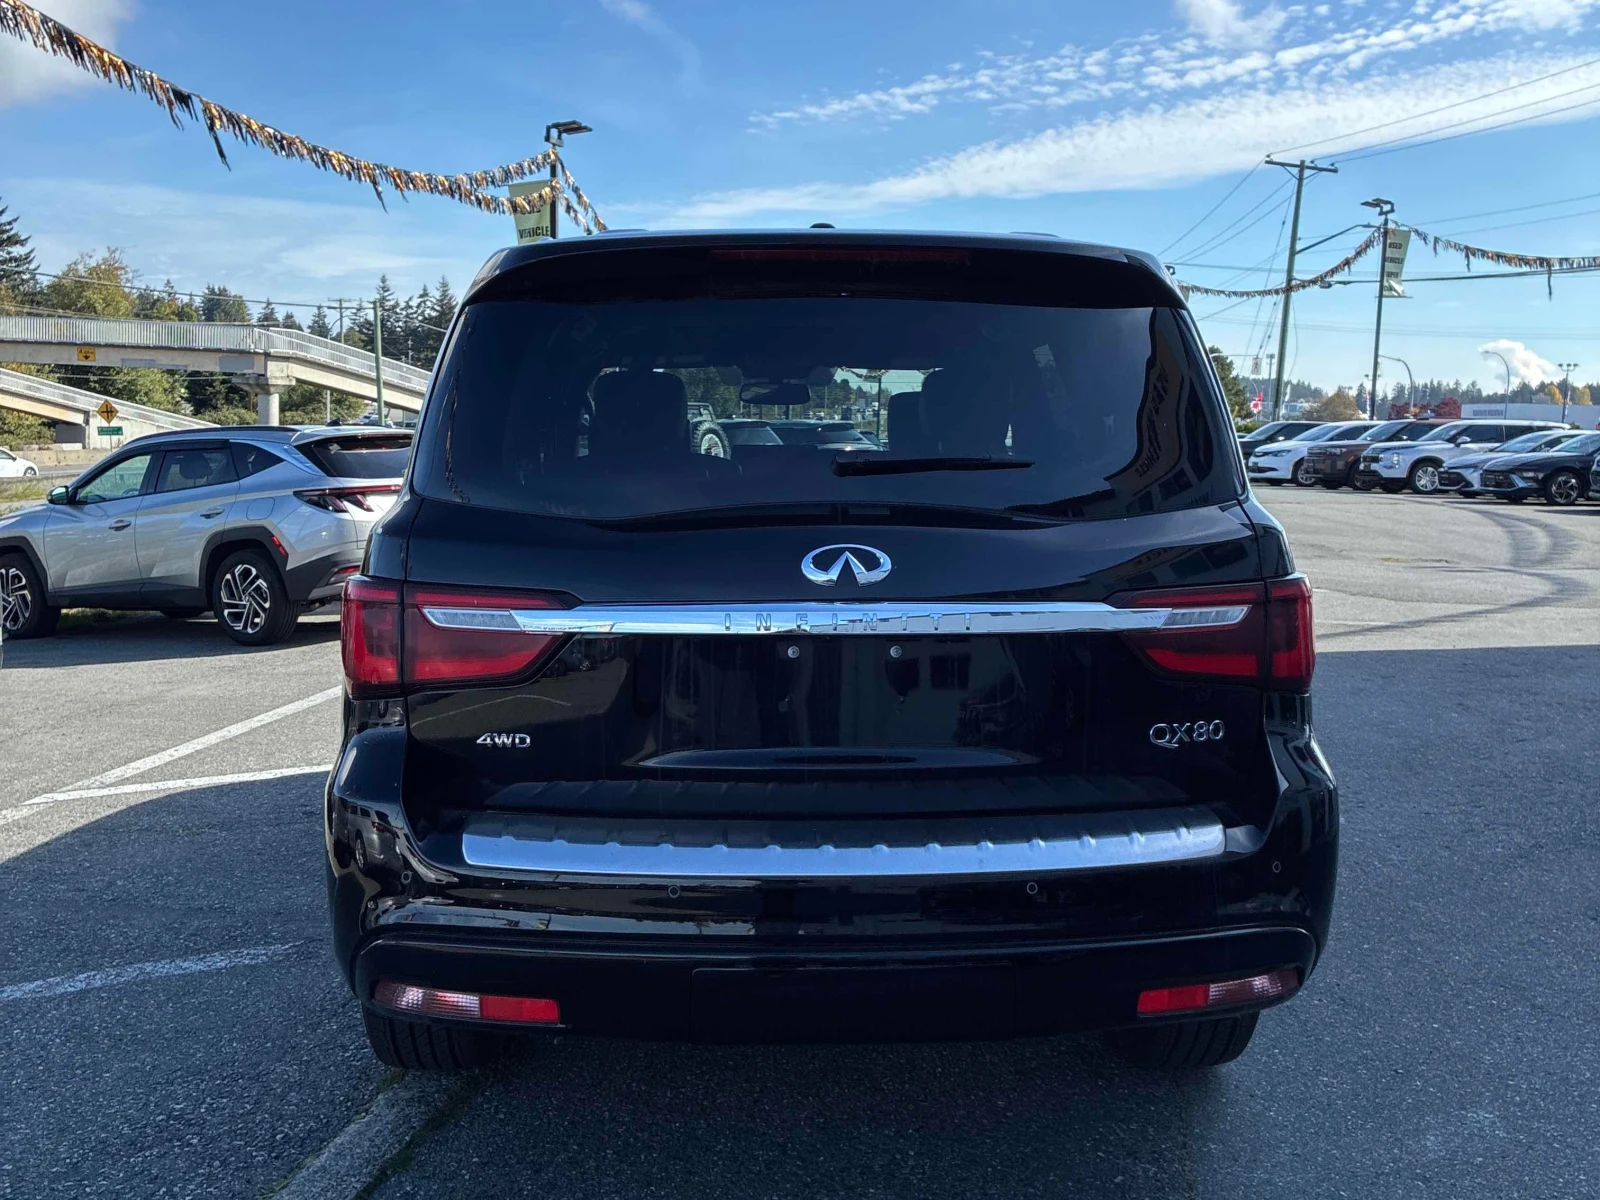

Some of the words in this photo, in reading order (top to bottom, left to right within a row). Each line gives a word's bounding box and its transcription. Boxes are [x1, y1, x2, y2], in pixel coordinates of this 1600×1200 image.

[518, 226, 550, 239] VEHICLE
[723, 613, 972, 632] INFINITI
[476, 733, 531, 748] 4WD
[1149, 720, 1225, 749] QX80
